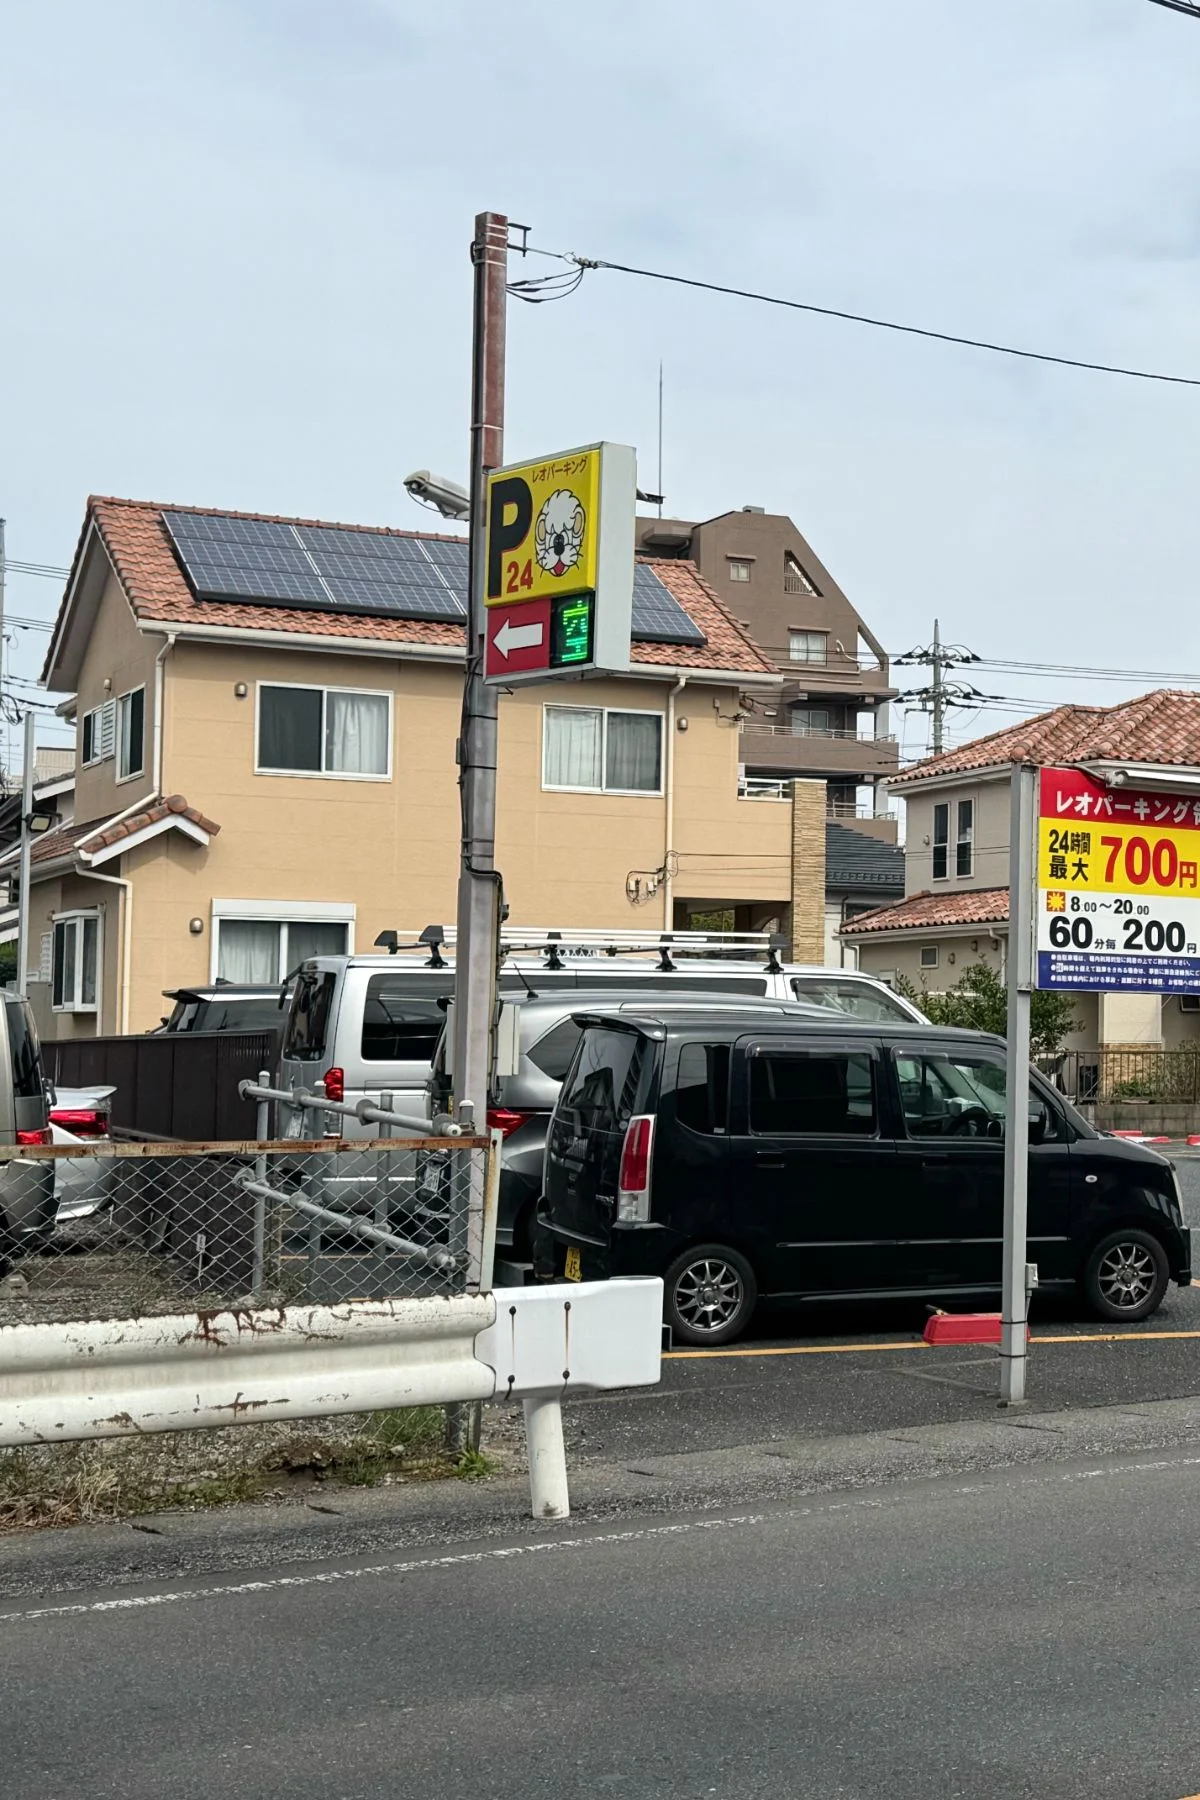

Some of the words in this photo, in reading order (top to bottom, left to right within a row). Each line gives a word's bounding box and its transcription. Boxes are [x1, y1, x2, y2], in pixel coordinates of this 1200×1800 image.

[532, 456, 588, 483] レオパーキング
[488, 477, 533, 600] P
[506, 558, 534, 594] 24
[1048, 829, 1092, 856] 24時間
[1048, 855, 1090, 882] 最大
[1100, 836, 1198, 889] 700円
[1122, 918, 1197, 955] 200円
